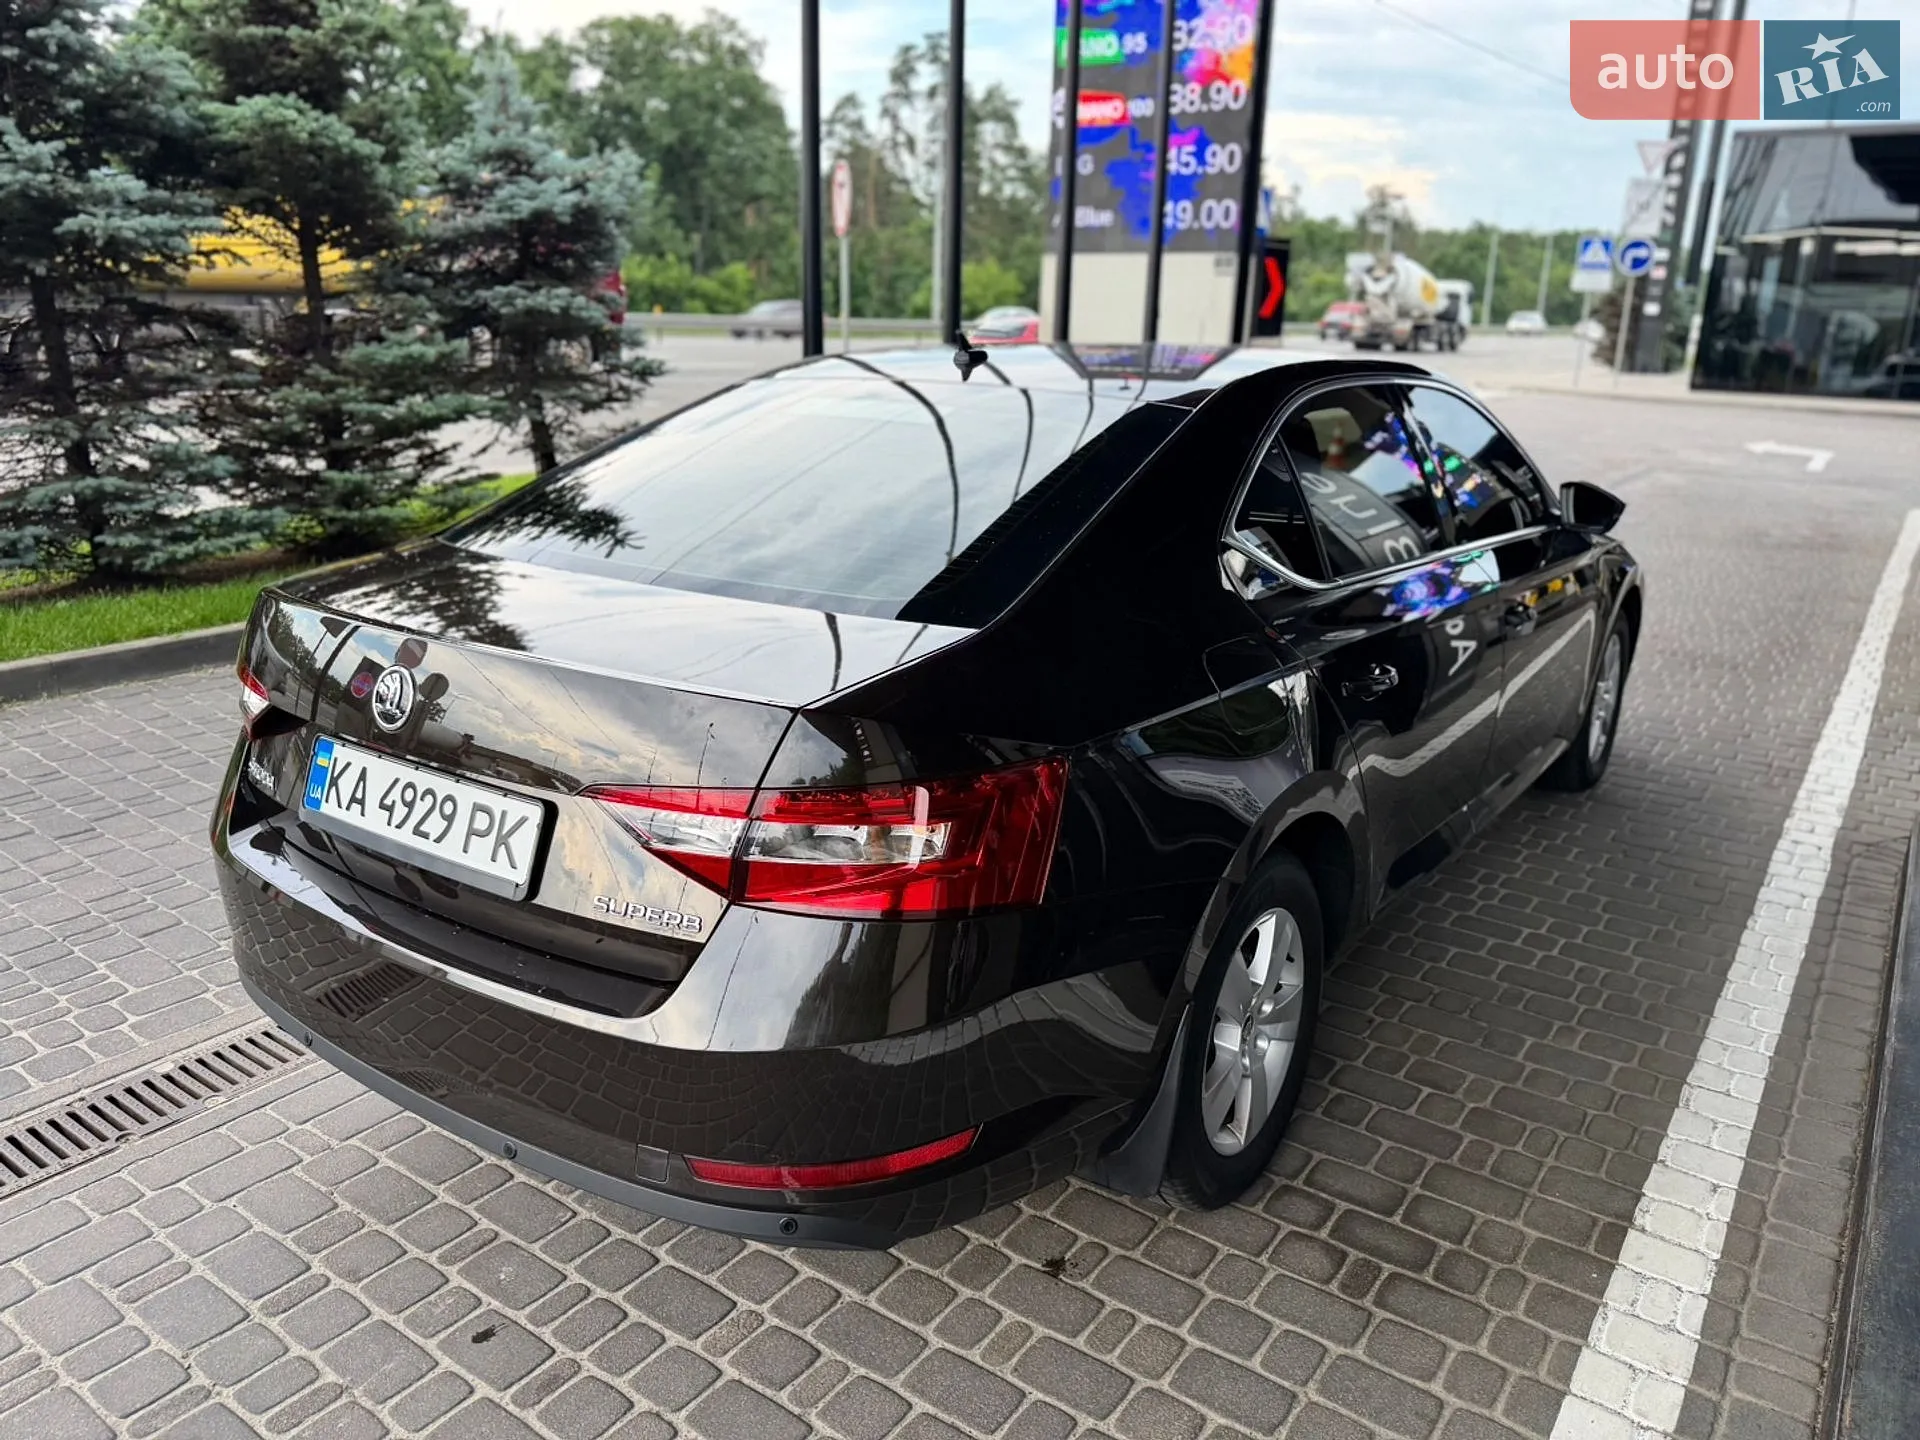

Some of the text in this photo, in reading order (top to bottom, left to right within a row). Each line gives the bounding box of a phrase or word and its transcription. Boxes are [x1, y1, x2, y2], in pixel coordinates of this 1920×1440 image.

[1169, 80, 1247, 115] 38.90
[309, 783, 322, 800] UA
[325, 756, 529, 870] KA 4929 PK
[593, 895, 703, 934] SUPERB
